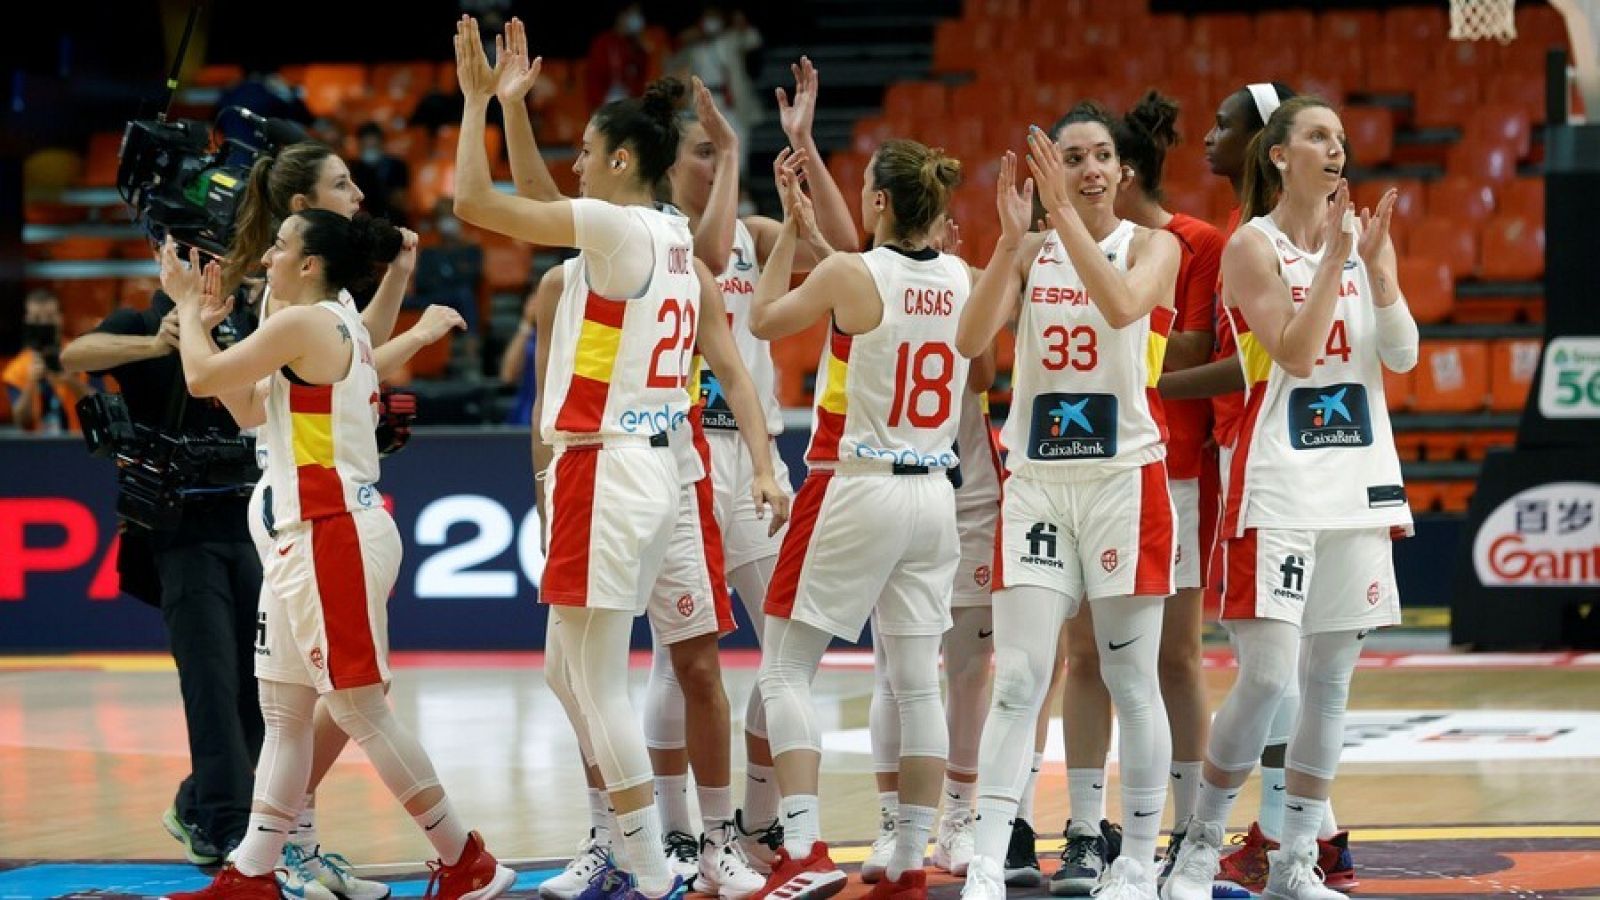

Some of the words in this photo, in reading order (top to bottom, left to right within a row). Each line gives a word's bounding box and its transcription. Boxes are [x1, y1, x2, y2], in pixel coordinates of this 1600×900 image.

[904, 287, 954, 316] CASAS
[646, 298, 696, 389] 22
[1041, 325, 1098, 372] 33
[886, 341, 955, 430] 18
[1038, 440, 1105, 457] CaixaBank
[1300, 430, 1363, 446] CaixaBank
[1025, 522, 1057, 559] fi
